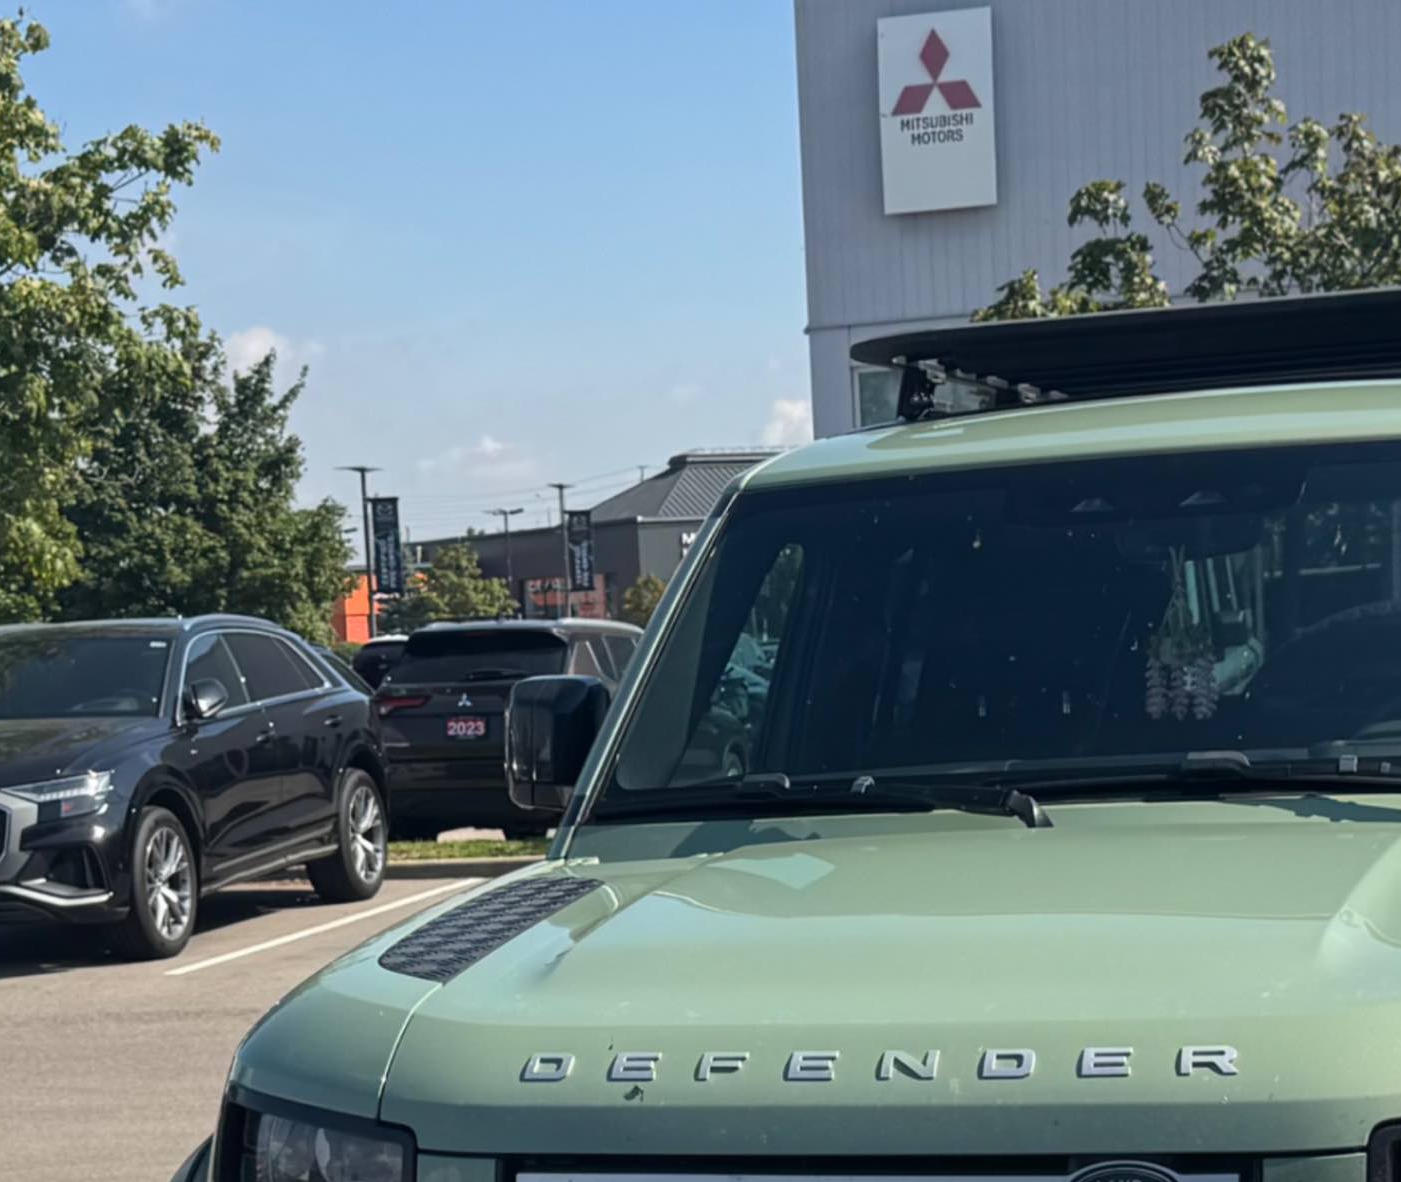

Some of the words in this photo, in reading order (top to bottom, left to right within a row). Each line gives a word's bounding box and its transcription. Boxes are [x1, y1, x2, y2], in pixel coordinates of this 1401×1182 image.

[900, 112, 974, 132] MITSUBISHI
[911, 128, 964, 145] MOTORS
[447, 721, 486, 736] 2023
[519, 1045, 1240, 1082] DEFENDER
